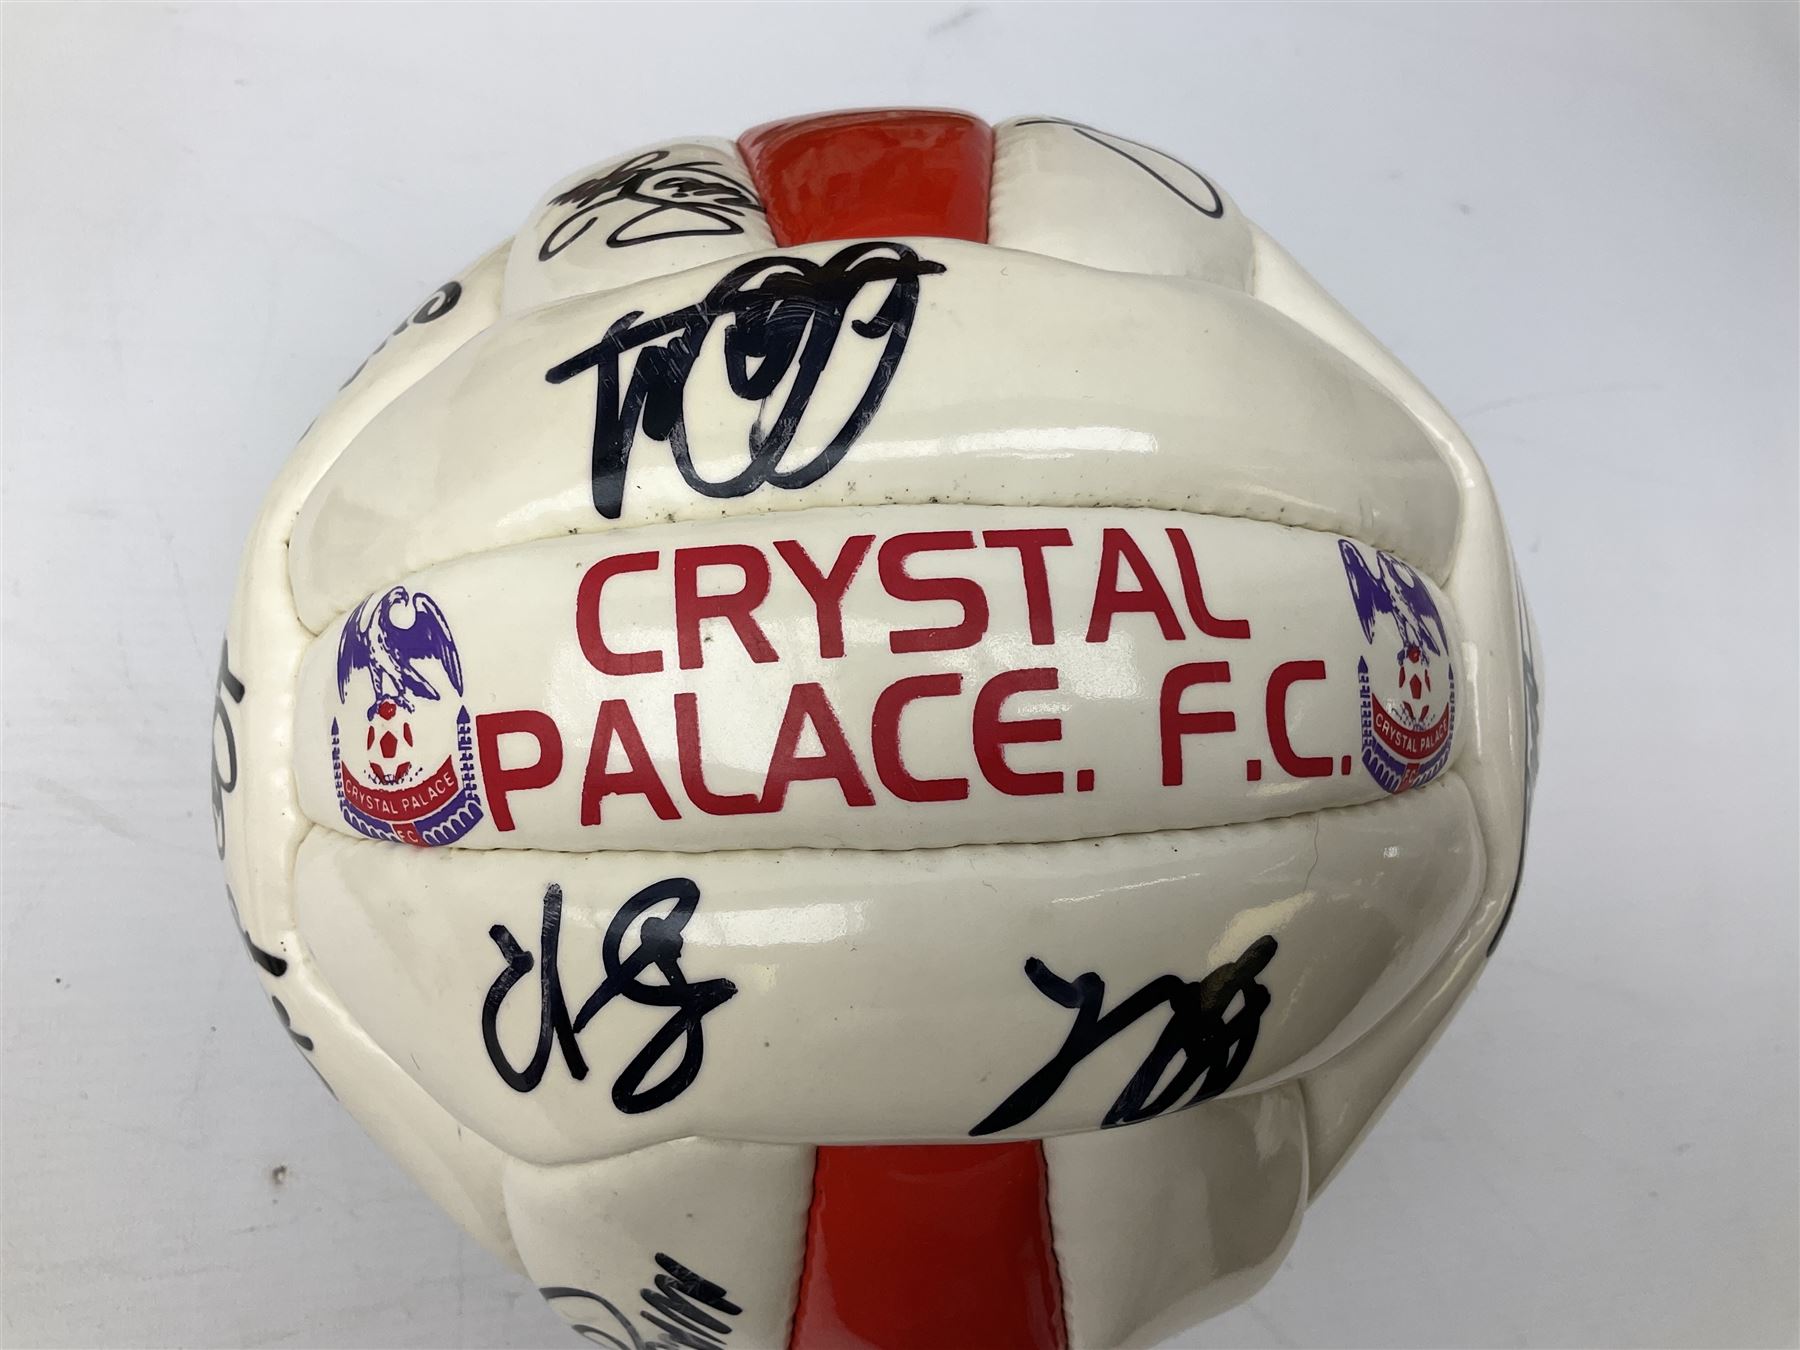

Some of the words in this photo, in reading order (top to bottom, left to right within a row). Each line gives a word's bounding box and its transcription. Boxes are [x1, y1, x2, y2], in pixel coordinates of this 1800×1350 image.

[576, 527, 1250, 676] CRYSTAL
[1161, 660, 1353, 787] F.C.
[1375, 714, 1417, 752] CRYSTAL
[1421, 719, 1448, 750] PALACE
[345, 779, 398, 815] CRYSTAL
[402, 772, 455, 811] PALACE
